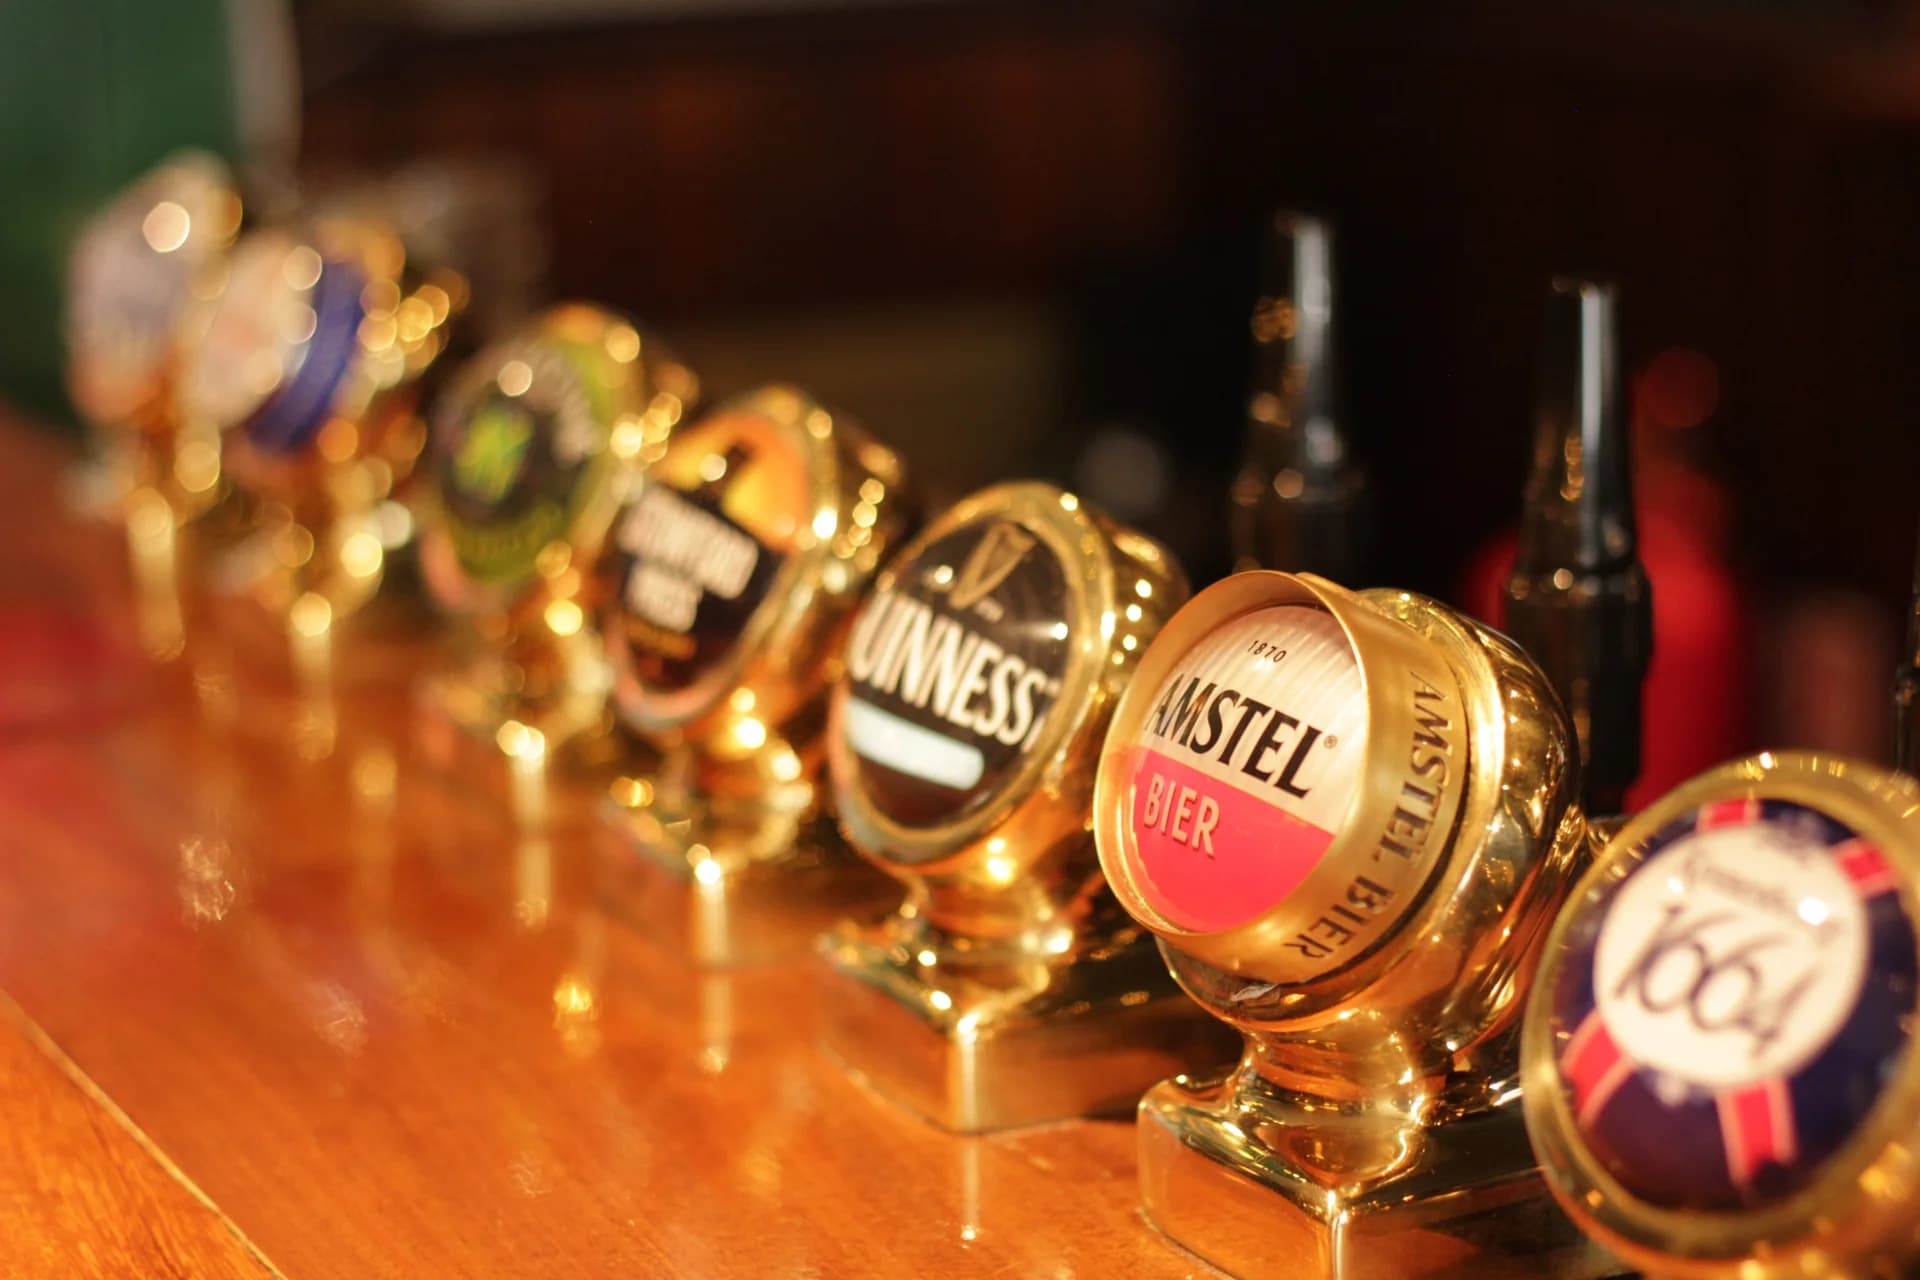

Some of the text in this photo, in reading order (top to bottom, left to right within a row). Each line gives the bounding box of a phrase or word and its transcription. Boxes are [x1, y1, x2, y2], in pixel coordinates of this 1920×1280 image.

[850, 588, 1049, 746] UINNESS
[1247, 639, 1288, 663] 1870
[1144, 673, 1322, 799] AMSTEL
[1144, 773, 1220, 860] BIER
[1283, 671, 1453, 959] AMSTEL BIER
[1612, 902, 1824, 1060] 1664
